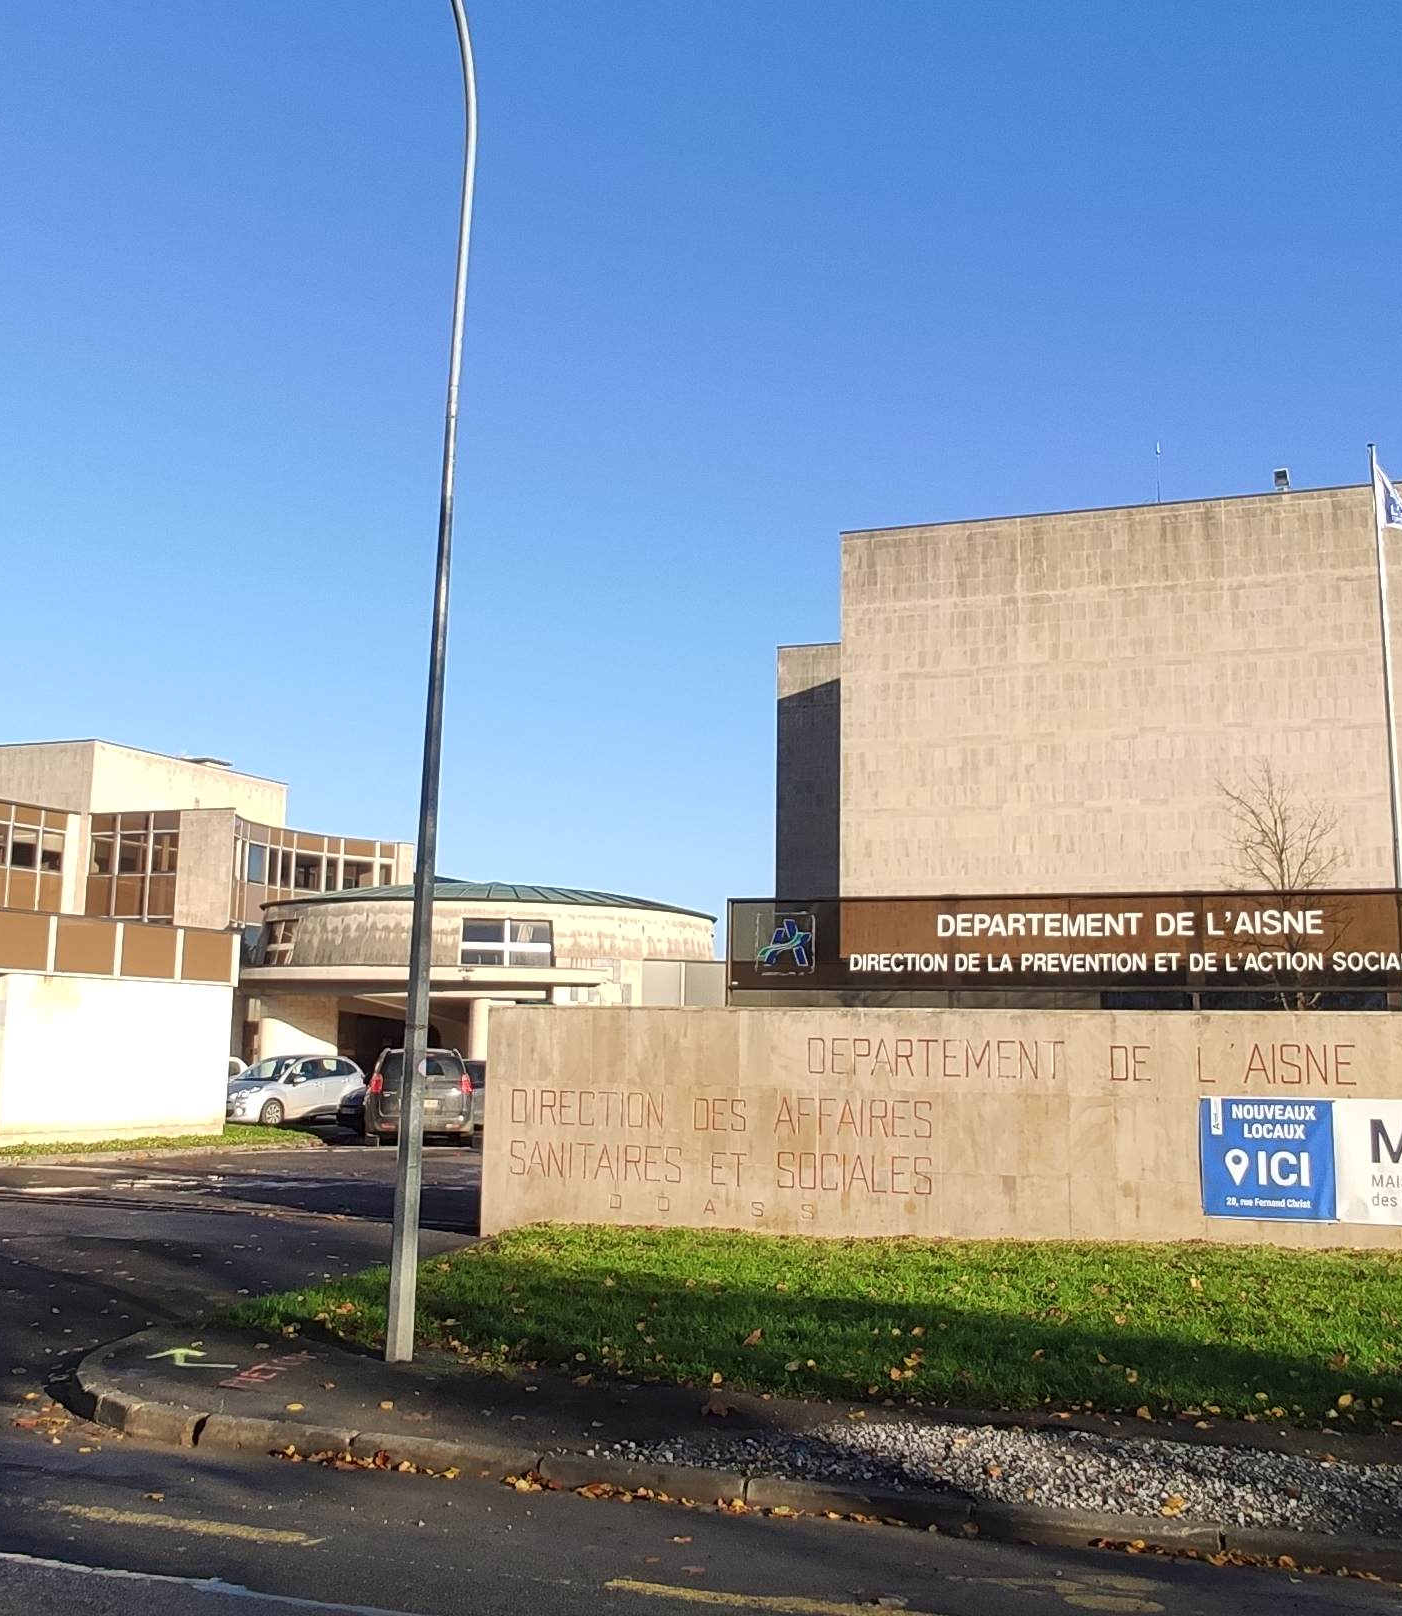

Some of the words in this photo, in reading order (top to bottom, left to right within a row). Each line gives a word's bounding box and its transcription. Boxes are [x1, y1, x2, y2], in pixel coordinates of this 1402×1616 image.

[936, 912, 1143, 937] DEPARTEMENT
[1154, 911, 1196, 936] DE
[1206, 909, 1325, 936] L'AISNE
[849, 953, 948, 973] DIRECTION
[954, 953, 981, 972] DE
[987, 953, 1014, 973] LA
[1020, 952, 1147, 973] PREVENTION
[1154, 952, 1181, 972] ET
[1189, 952, 1217, 972] DE
[1224, 951, 1324, 972] L'ACTION
[807, 1036, 1065, 1079] DEPARTEMENT
[1109, 1044, 1152, 1082] DE
[510, 1087, 665, 1129] DIRECTION
[694, 1097, 747, 1132] DES
[773, 1096, 933, 1139] AFFAIRES
[1231, 1103, 1317, 1121] NOUVEAUX
[1242, 1122, 1307, 1140] LOCAUX
[509, 1139, 683, 1184] SANITAIRES
[710, 1151, 748, 1188] ET
[776, 1150, 933, 1196] SOCIALES
[1256, 1150, 1311, 1187] ICI
[1240, 1198, 1254, 1207] rue
[1254, 1197, 1286, 1208] Fernand
[1286, 1198, 1312, 1209] Christ
[1371, 1192, 1399, 1209] des
